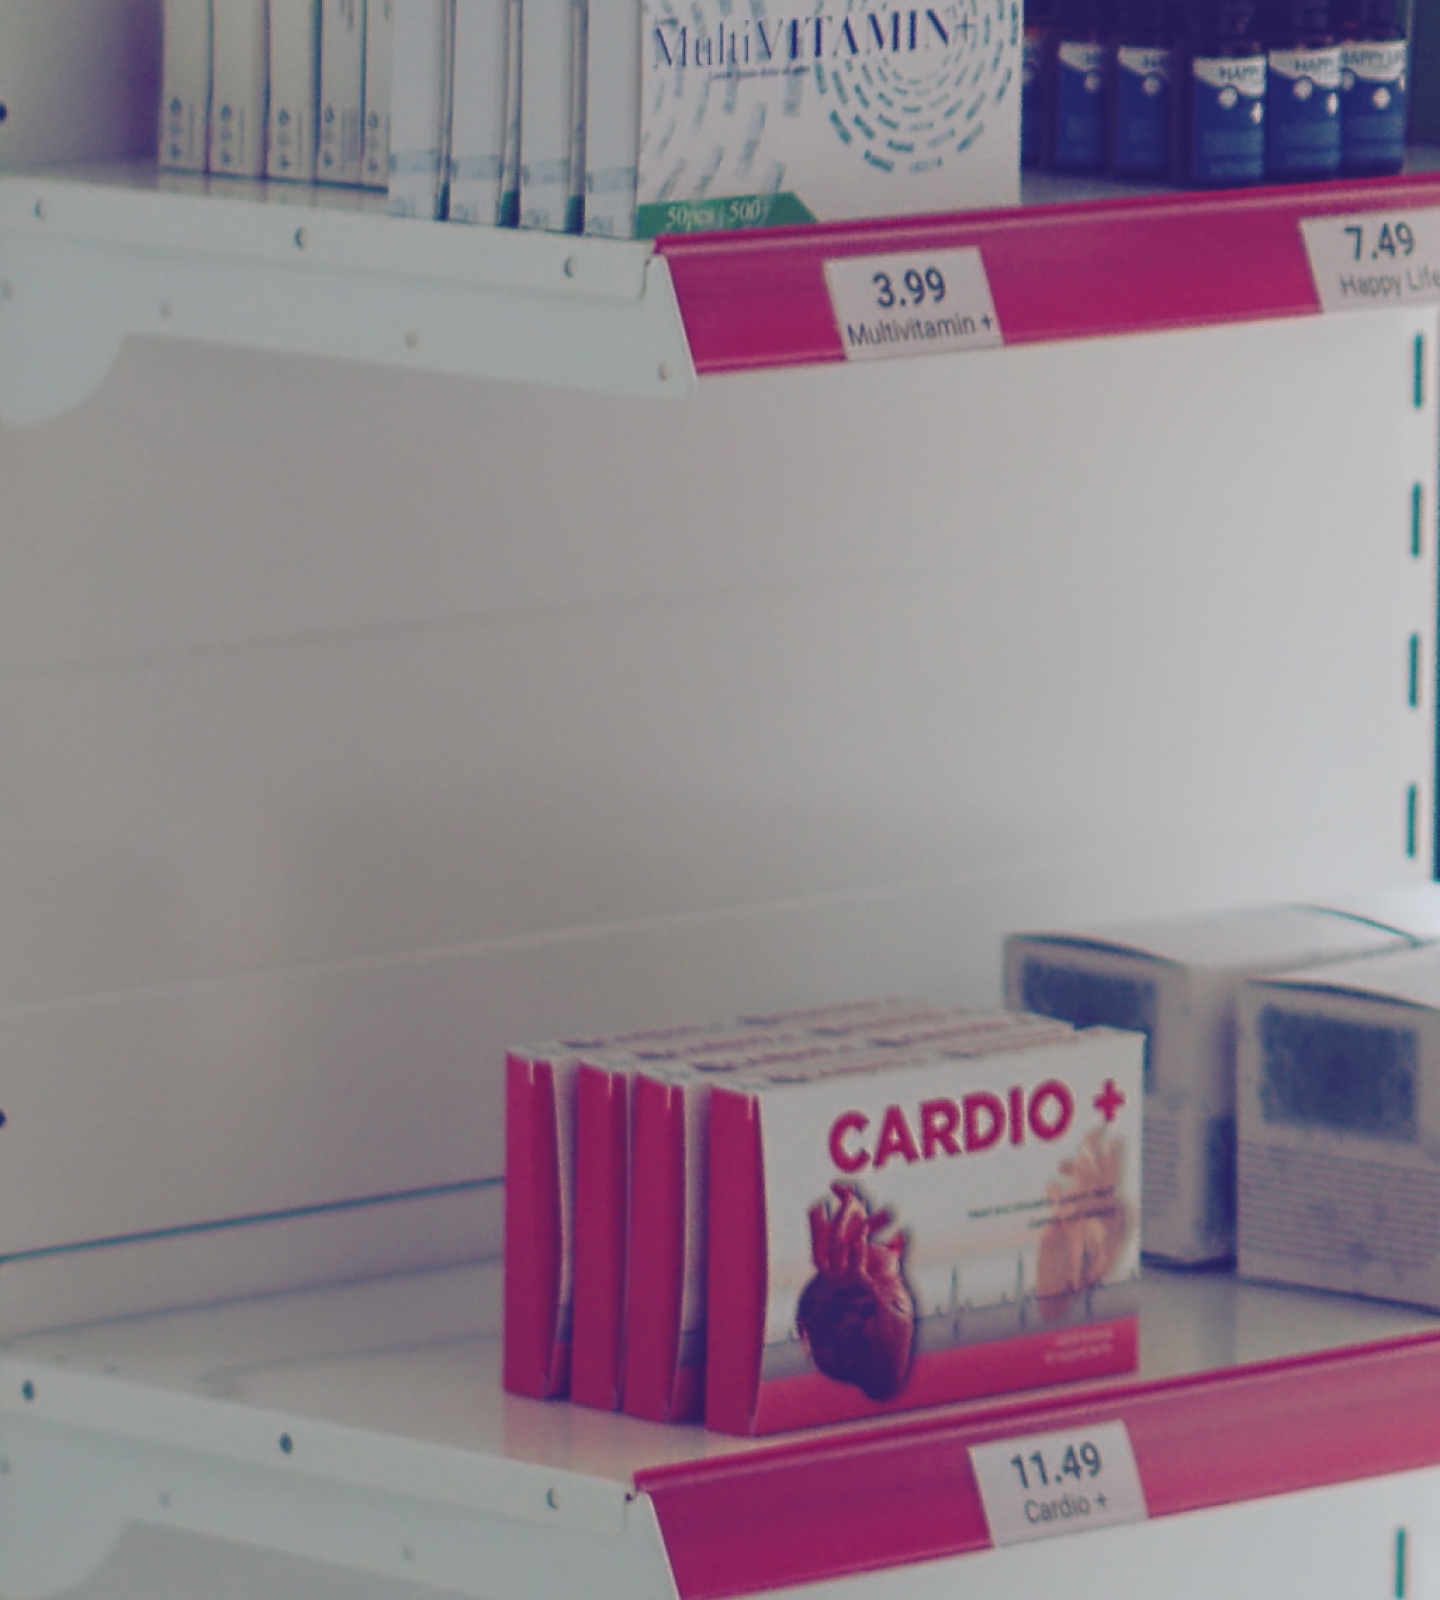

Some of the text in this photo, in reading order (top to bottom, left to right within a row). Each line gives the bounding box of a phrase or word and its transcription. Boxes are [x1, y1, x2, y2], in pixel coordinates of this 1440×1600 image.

[1343, 220, 1416, 262] 7.49
[872, 265, 946, 309] 3.99
[1338, 272, 1403, 298] Happy
[847, 311, 977, 348] Multivitamin
[828, 1079, 1075, 1175] CARDIO
[1009, 1441, 1102, 1490] 11.49
[1023, 1494, 1091, 1524] Cardio
